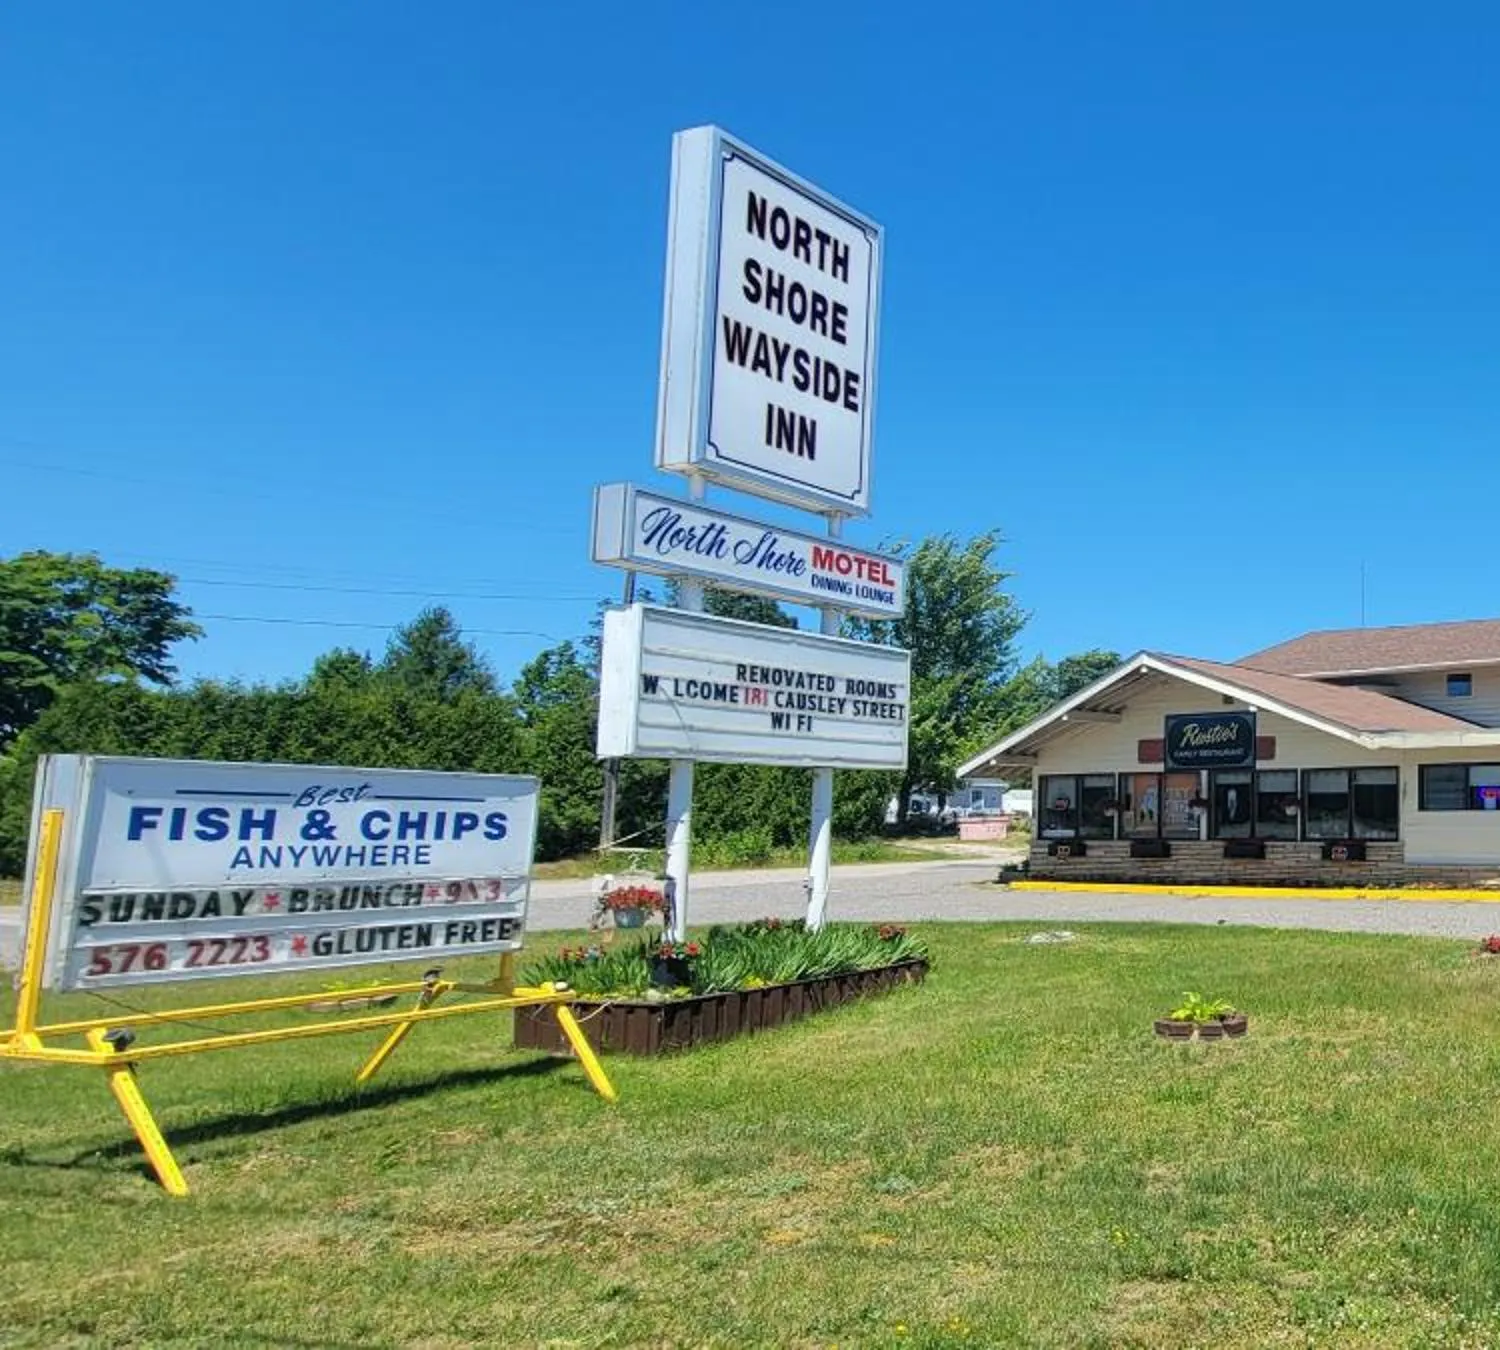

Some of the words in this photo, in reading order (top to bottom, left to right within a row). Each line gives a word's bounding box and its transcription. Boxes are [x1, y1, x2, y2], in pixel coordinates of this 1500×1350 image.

[746, 189, 849, 284] NORTH
[742, 257, 849, 345] SHORE
[722, 314, 861, 413] WAYSIDE
[765, 402, 817, 461] INN
[640, 506, 730, 560] North
[733, 530, 806, 577] Shore
[811, 544, 895, 588] MOTEL
[811, 573, 853, 596] DINING
[855, 584, 895, 606] LOUNGE
[736, 663, 835, 693] RENOVATED
[845, 678, 897, 699] ROOMS
[771, 711, 791, 730] WI
[797, 714, 813, 732] FI
[774, 690, 847, 715] CAUSLEY
[852, 698, 906, 721] STREET
[293, 783, 372, 809] Best
[127, 807, 277, 841] FISH
[301, 810, 338, 841] &
[360, 810, 509, 841] CHIPS
[230, 845, 432, 869] ANYWHERE
[79, 891, 255, 926] SUNDAY
[287, 884, 425, 913] BRUNCH
[87, 943, 168, 976] 576
[184, 936, 271, 968] 2223
[312, 922, 433, 956] GLUTEN
[444, 917, 514, 944] FREE
